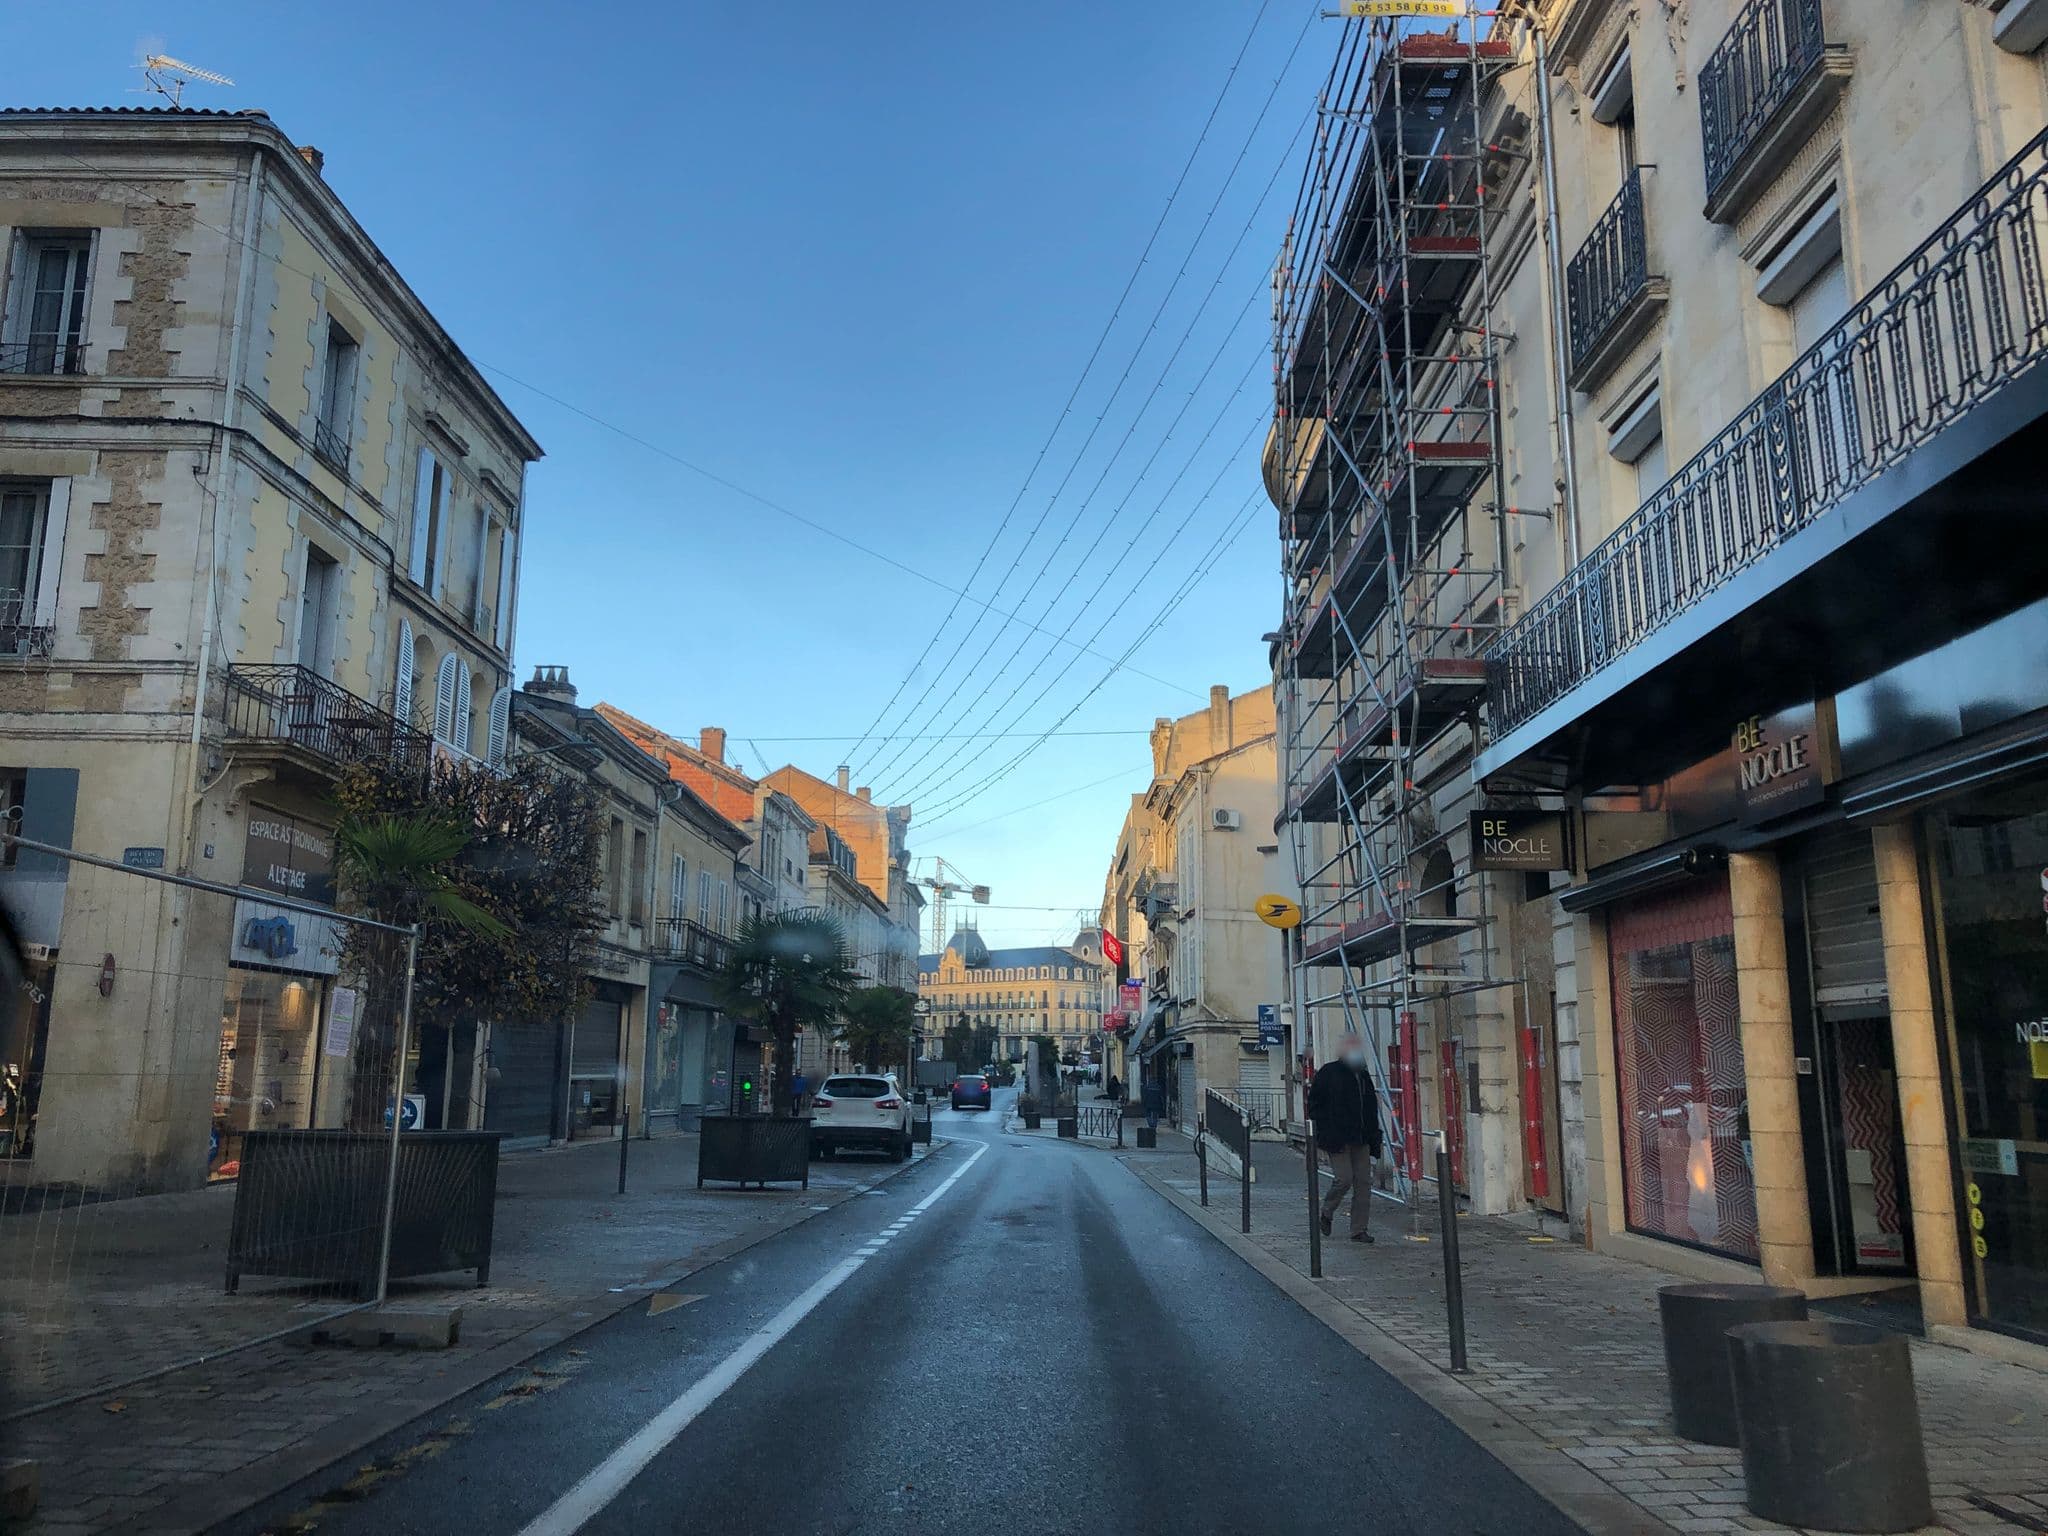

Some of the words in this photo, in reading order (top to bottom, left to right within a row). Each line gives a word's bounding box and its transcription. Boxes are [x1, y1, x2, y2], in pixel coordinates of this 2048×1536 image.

[1357, 4, 1371, 13] 05
[1377, 3, 1391, 12] 53
[1396, 2, 1409, 11] 58
[1433, 4, 1447, 13] 99
[1737, 714, 1764, 753] BE
[1740, 734, 1808, 791] NOCLE
[249, 820, 280, 841] ESPACE
[280, 823, 329, 858] ASTRONOMIE
[1482, 820, 1508, 836] BE
[1483, 838, 1551, 854] NOCLE
